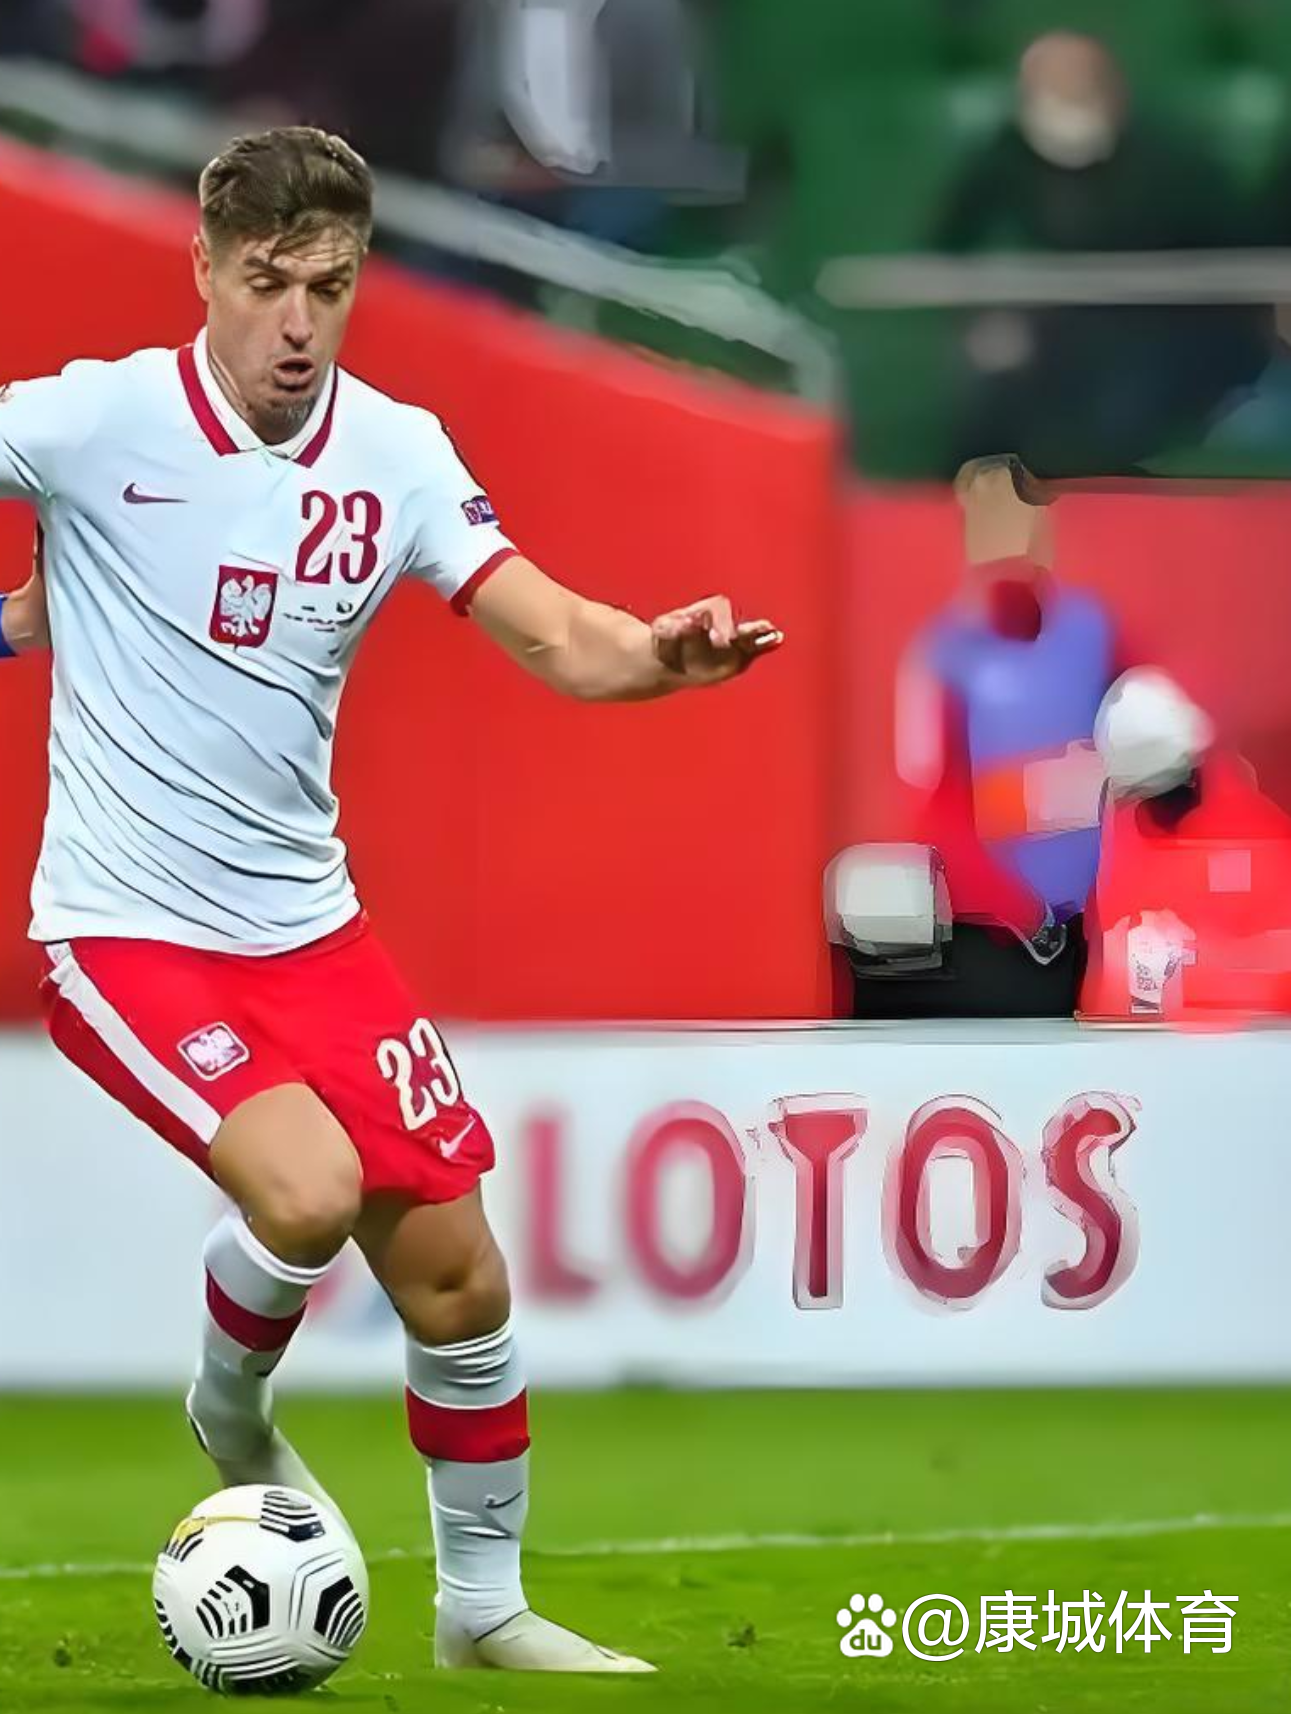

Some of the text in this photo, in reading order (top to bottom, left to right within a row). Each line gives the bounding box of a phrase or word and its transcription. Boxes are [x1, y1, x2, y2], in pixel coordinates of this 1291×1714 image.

[294, 489, 383, 585] 23
[375, 1016, 462, 1132] 23
[516, 1090, 1142, 1312] LOTOS
